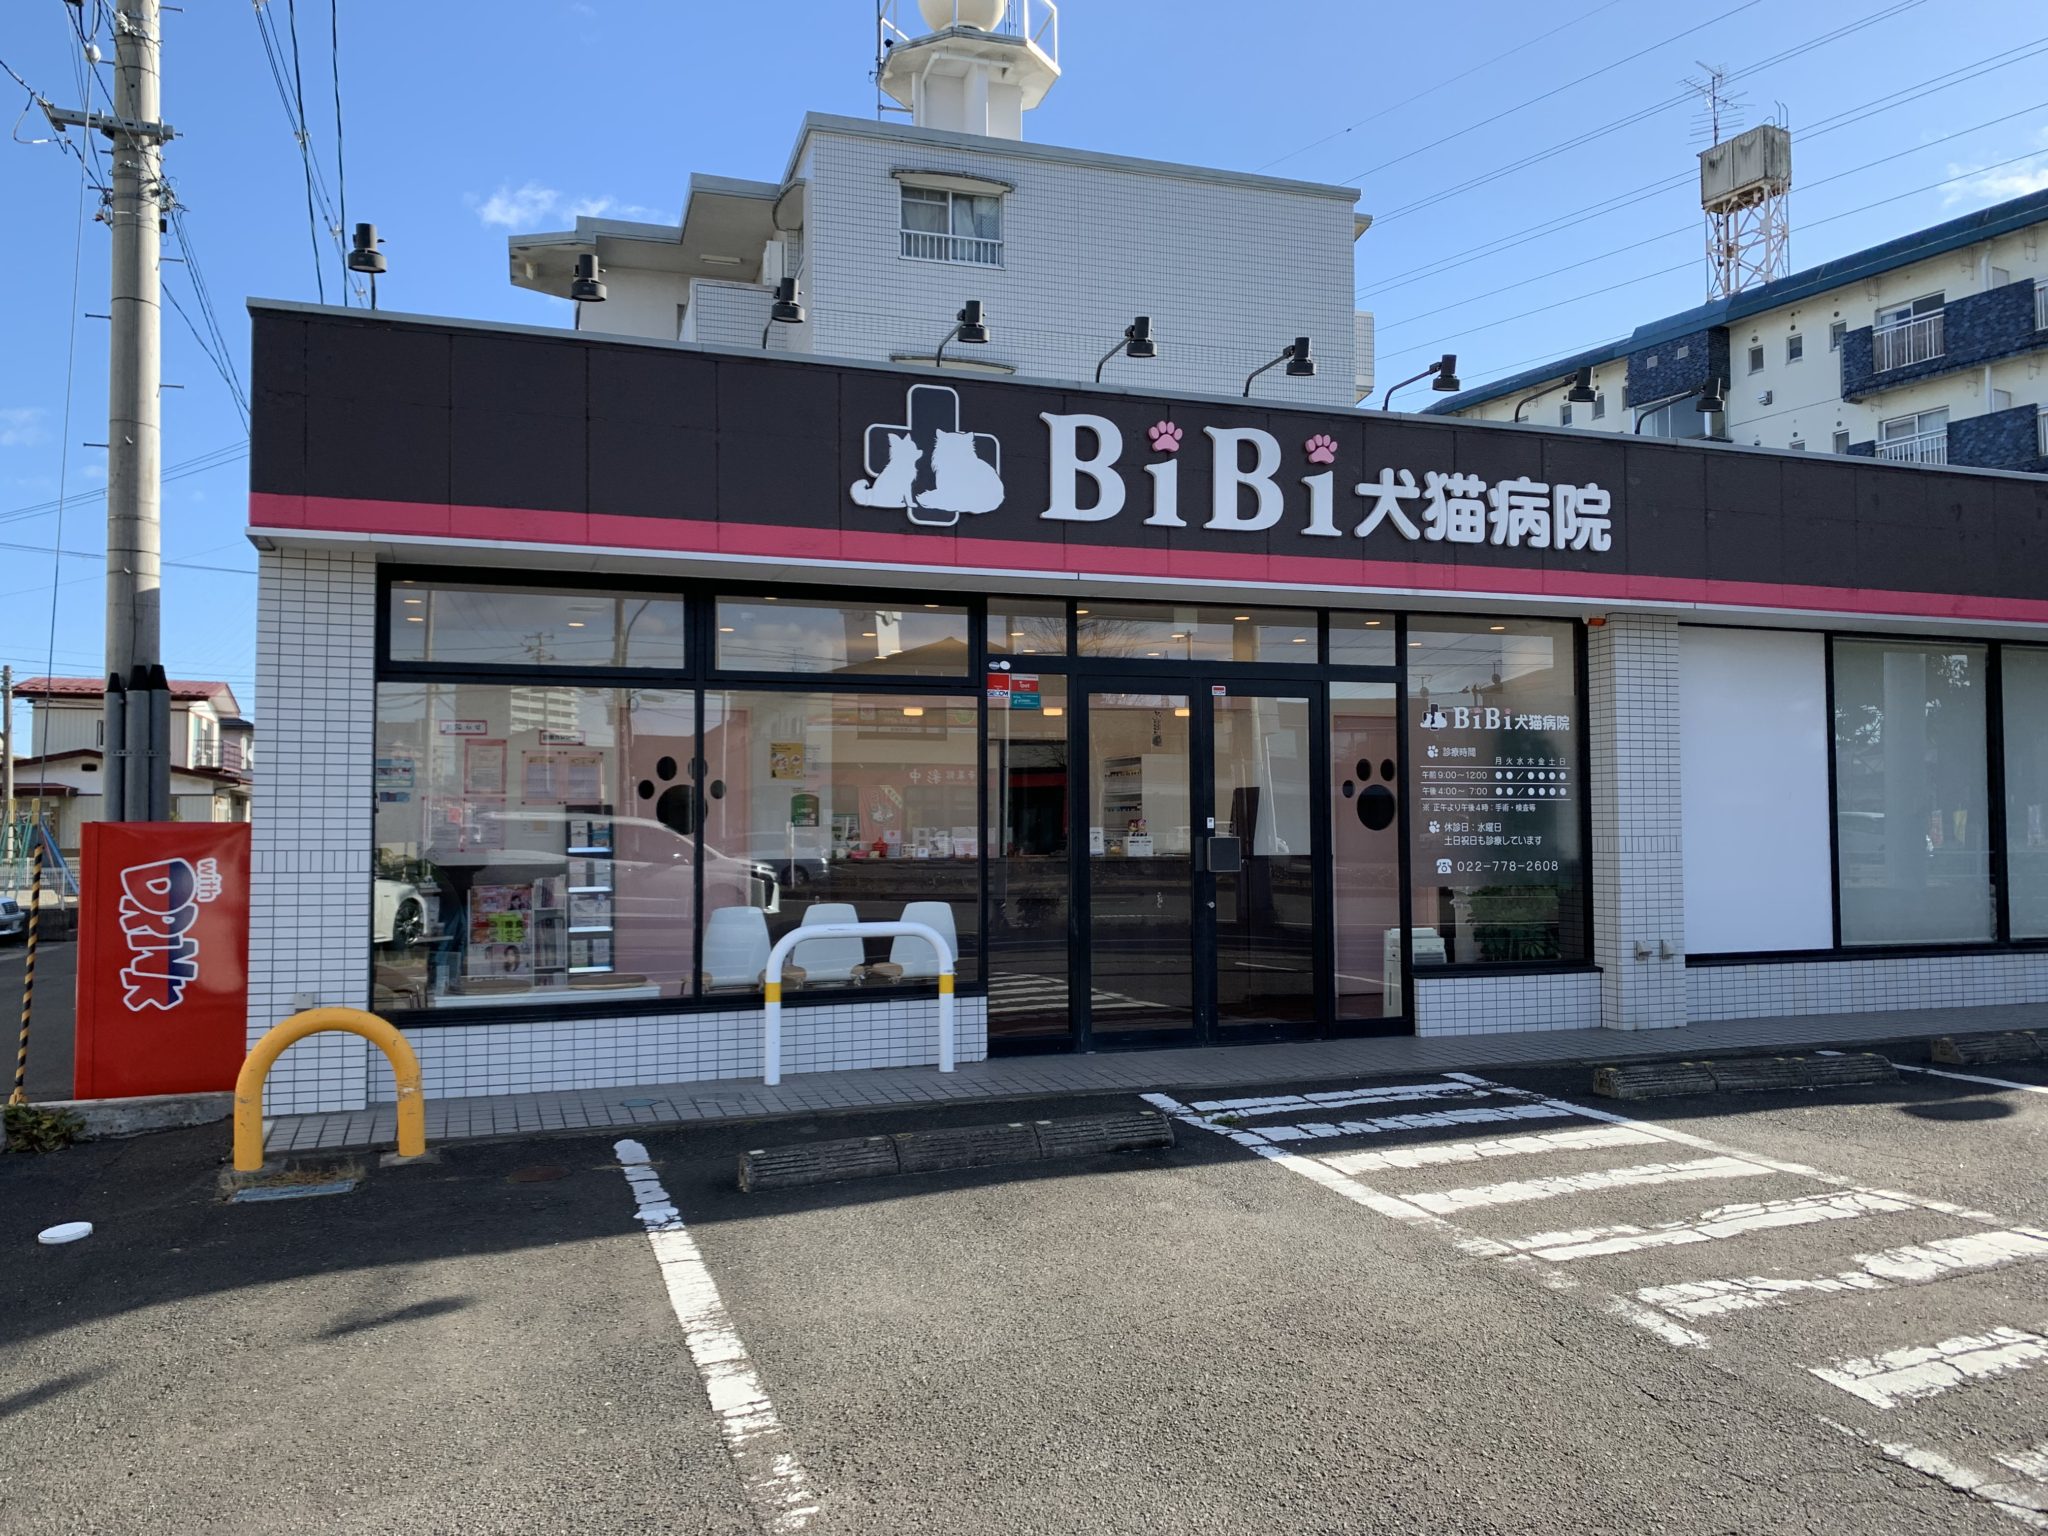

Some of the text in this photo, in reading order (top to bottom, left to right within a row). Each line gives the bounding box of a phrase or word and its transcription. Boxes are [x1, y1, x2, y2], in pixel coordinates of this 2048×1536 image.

[1443, 747, 1476, 757] 診療時間
[1444, 836, 1542, 846] 土日祝日も診療しています
[1457, 861, 1559, 871] 022-778-2608
[119, 857, 199, 1012] DRINK
